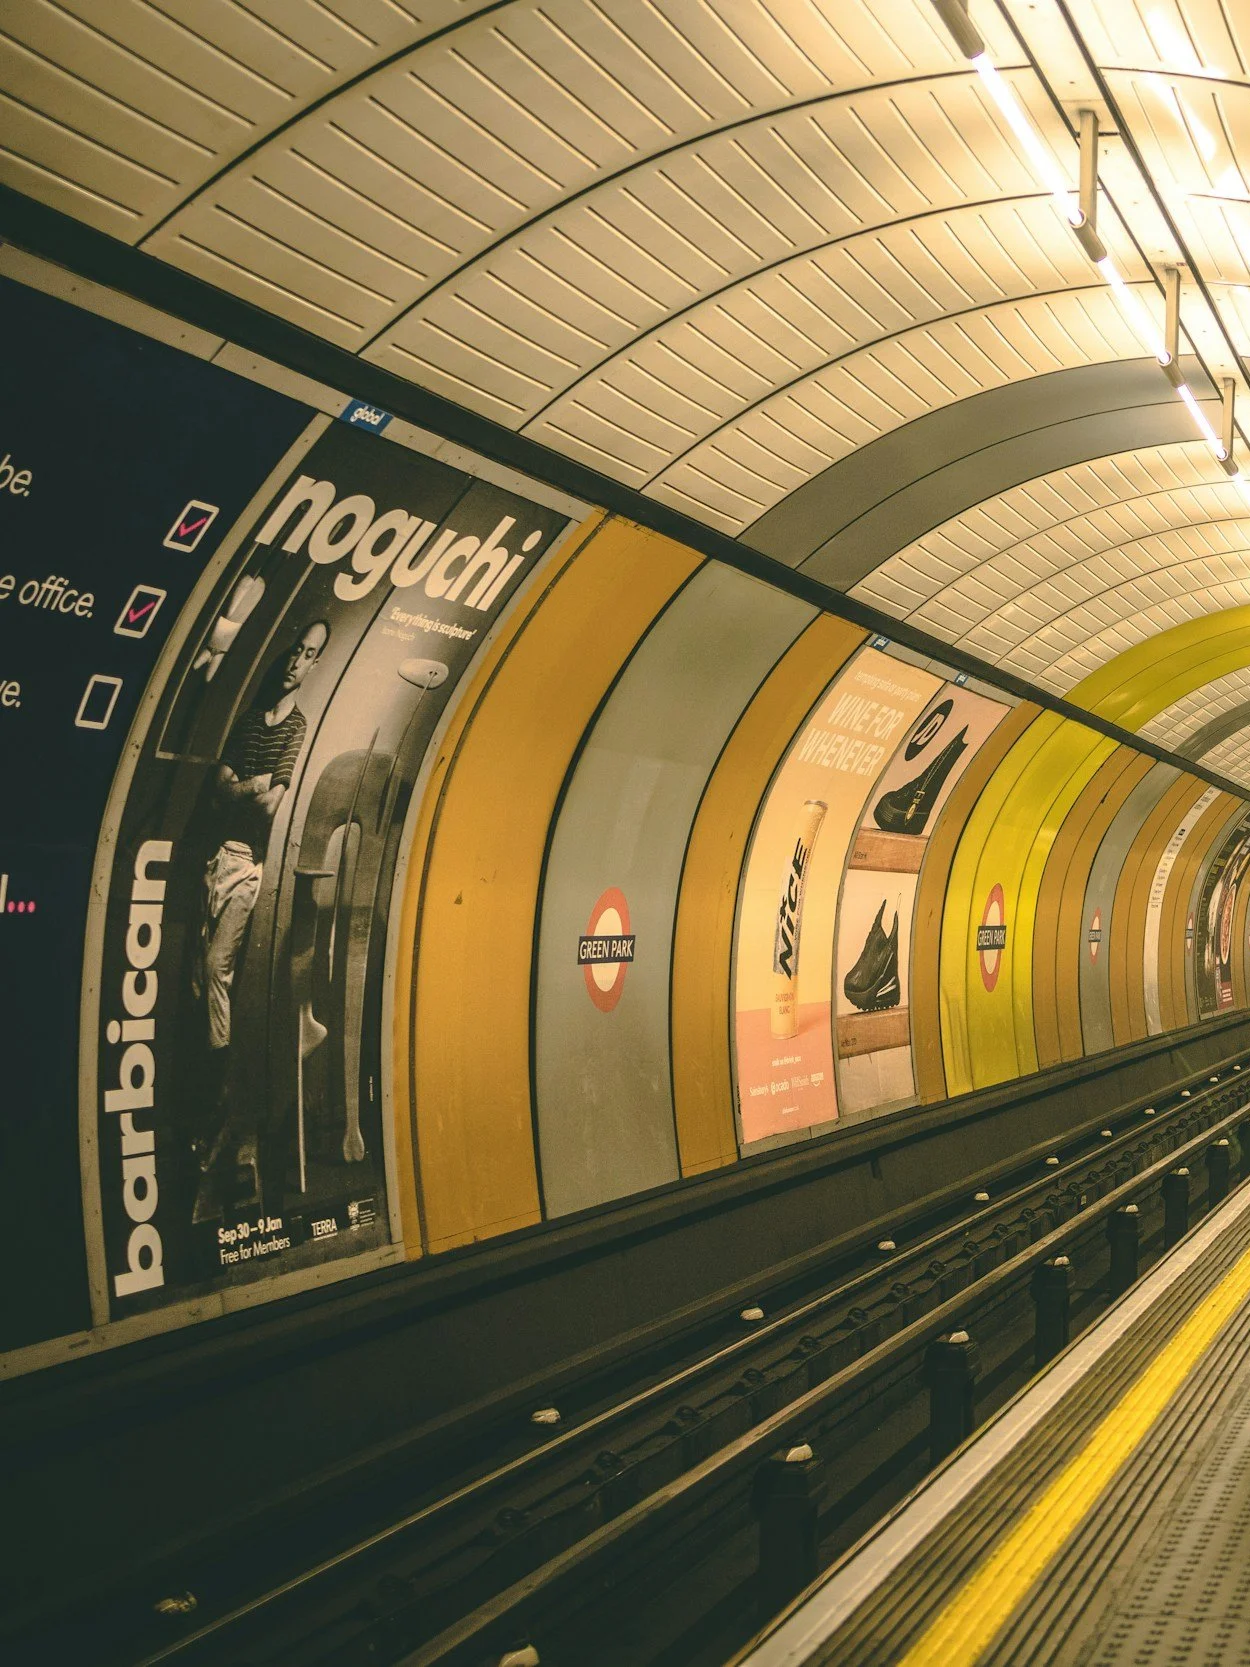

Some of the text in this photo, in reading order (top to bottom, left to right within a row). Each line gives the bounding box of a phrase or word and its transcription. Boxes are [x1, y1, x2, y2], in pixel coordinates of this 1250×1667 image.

[254, 473, 543, 612] noguchi
[18, 575, 95, 618] office.
[827, 692, 905, 741] WINE FOR
[911, 712, 945, 746] JD
[796, 727, 886, 777] WHENEVER
[779, 837, 808, 981] NICE
[580, 939, 634, 960] GREEN PARK
[978, 929, 1006, 947] GREEN PARK
[103, 840, 174, 1298] barbican
[217, 1227, 238, 1246] Sep
[235, 1221, 250, 1240] 30
[257, 1218, 266, 1235] 9
[265, 1216, 283, 1234] Jan
[311, 1218, 338, 1237] TERRA
[220, 1235, 291, 1266] Free for Members
